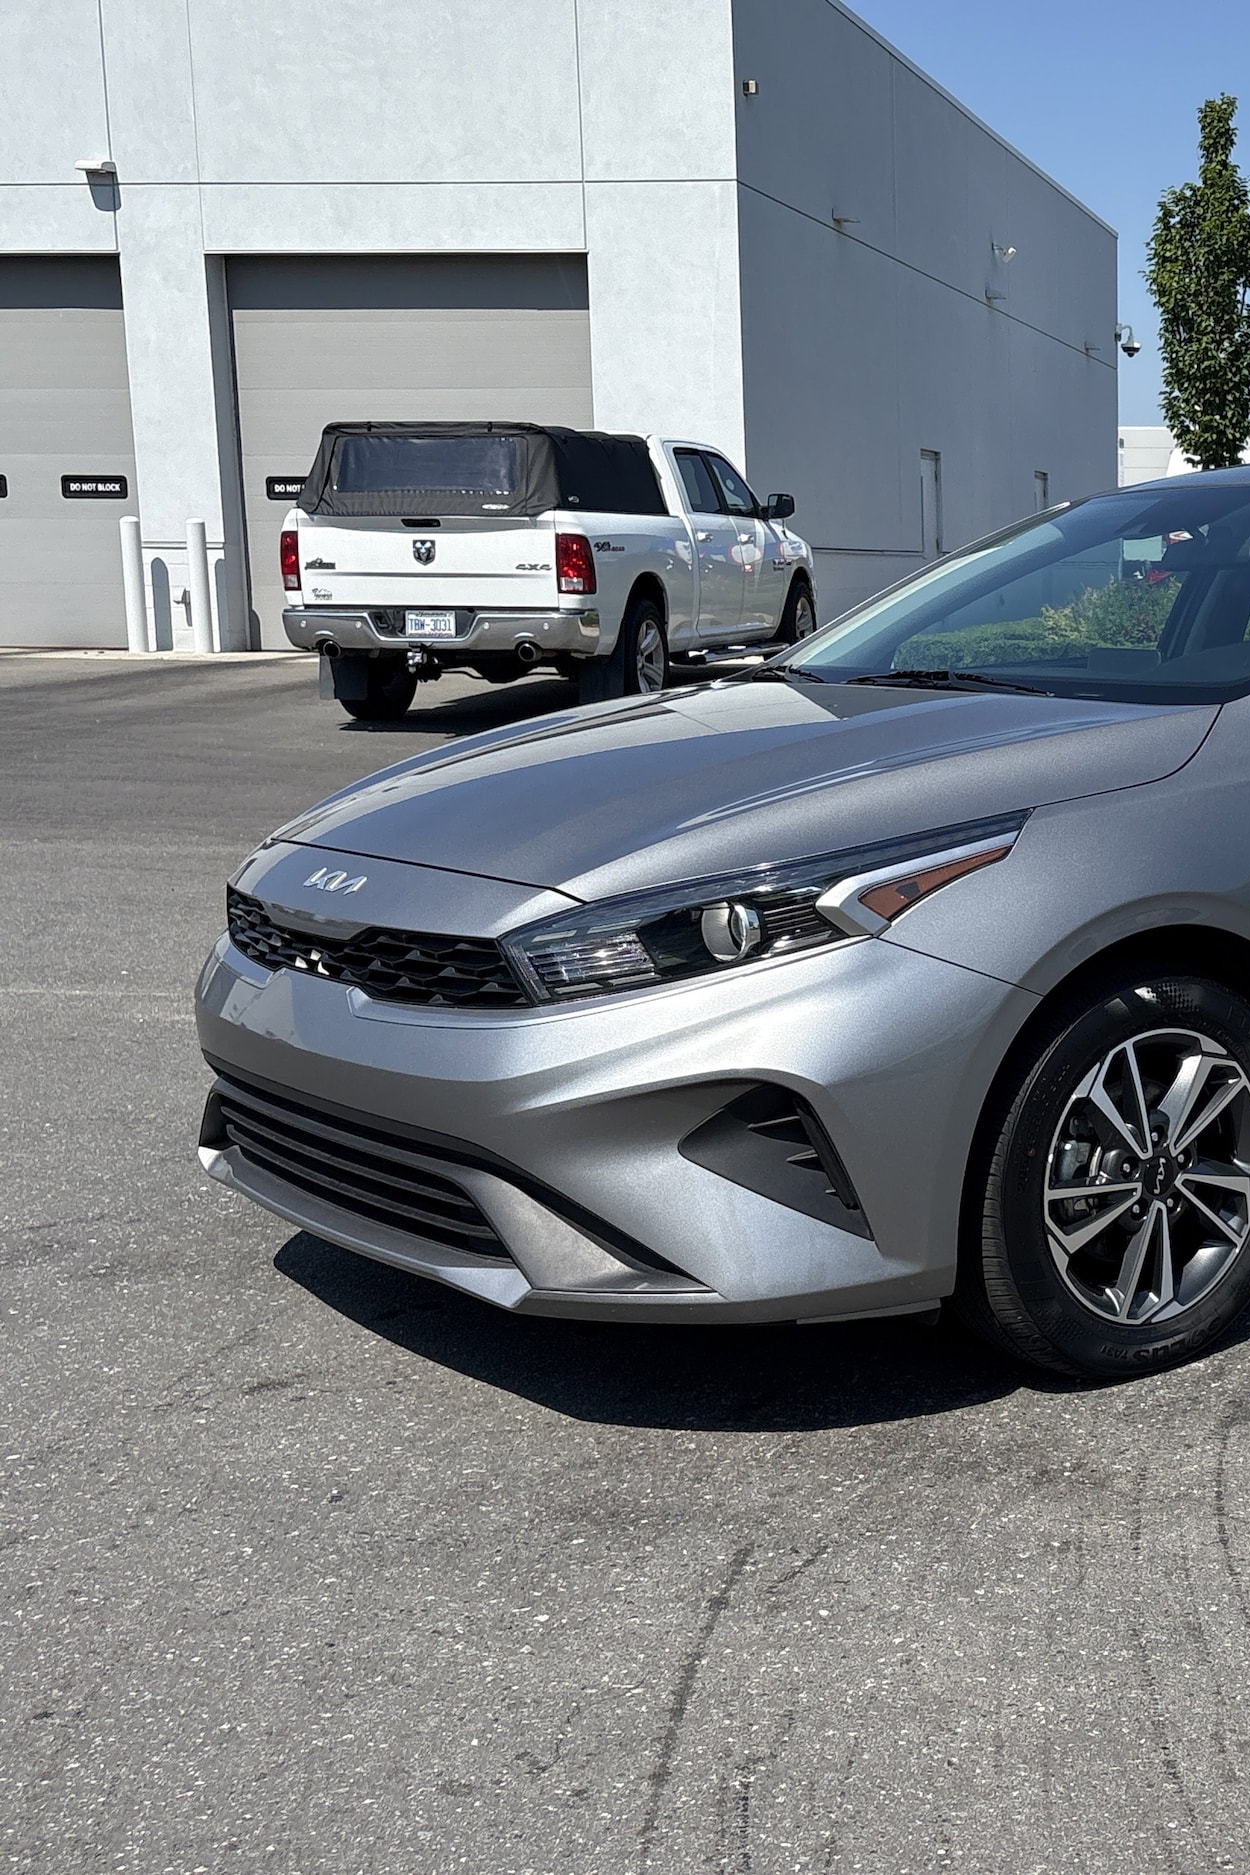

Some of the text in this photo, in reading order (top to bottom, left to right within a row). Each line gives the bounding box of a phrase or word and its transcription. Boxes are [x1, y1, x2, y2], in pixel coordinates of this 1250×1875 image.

[69, 482, 121, 492] DO NOT BLOCK
[274, 484, 285, 493] DO
[286, 484, 301, 493] NOT
